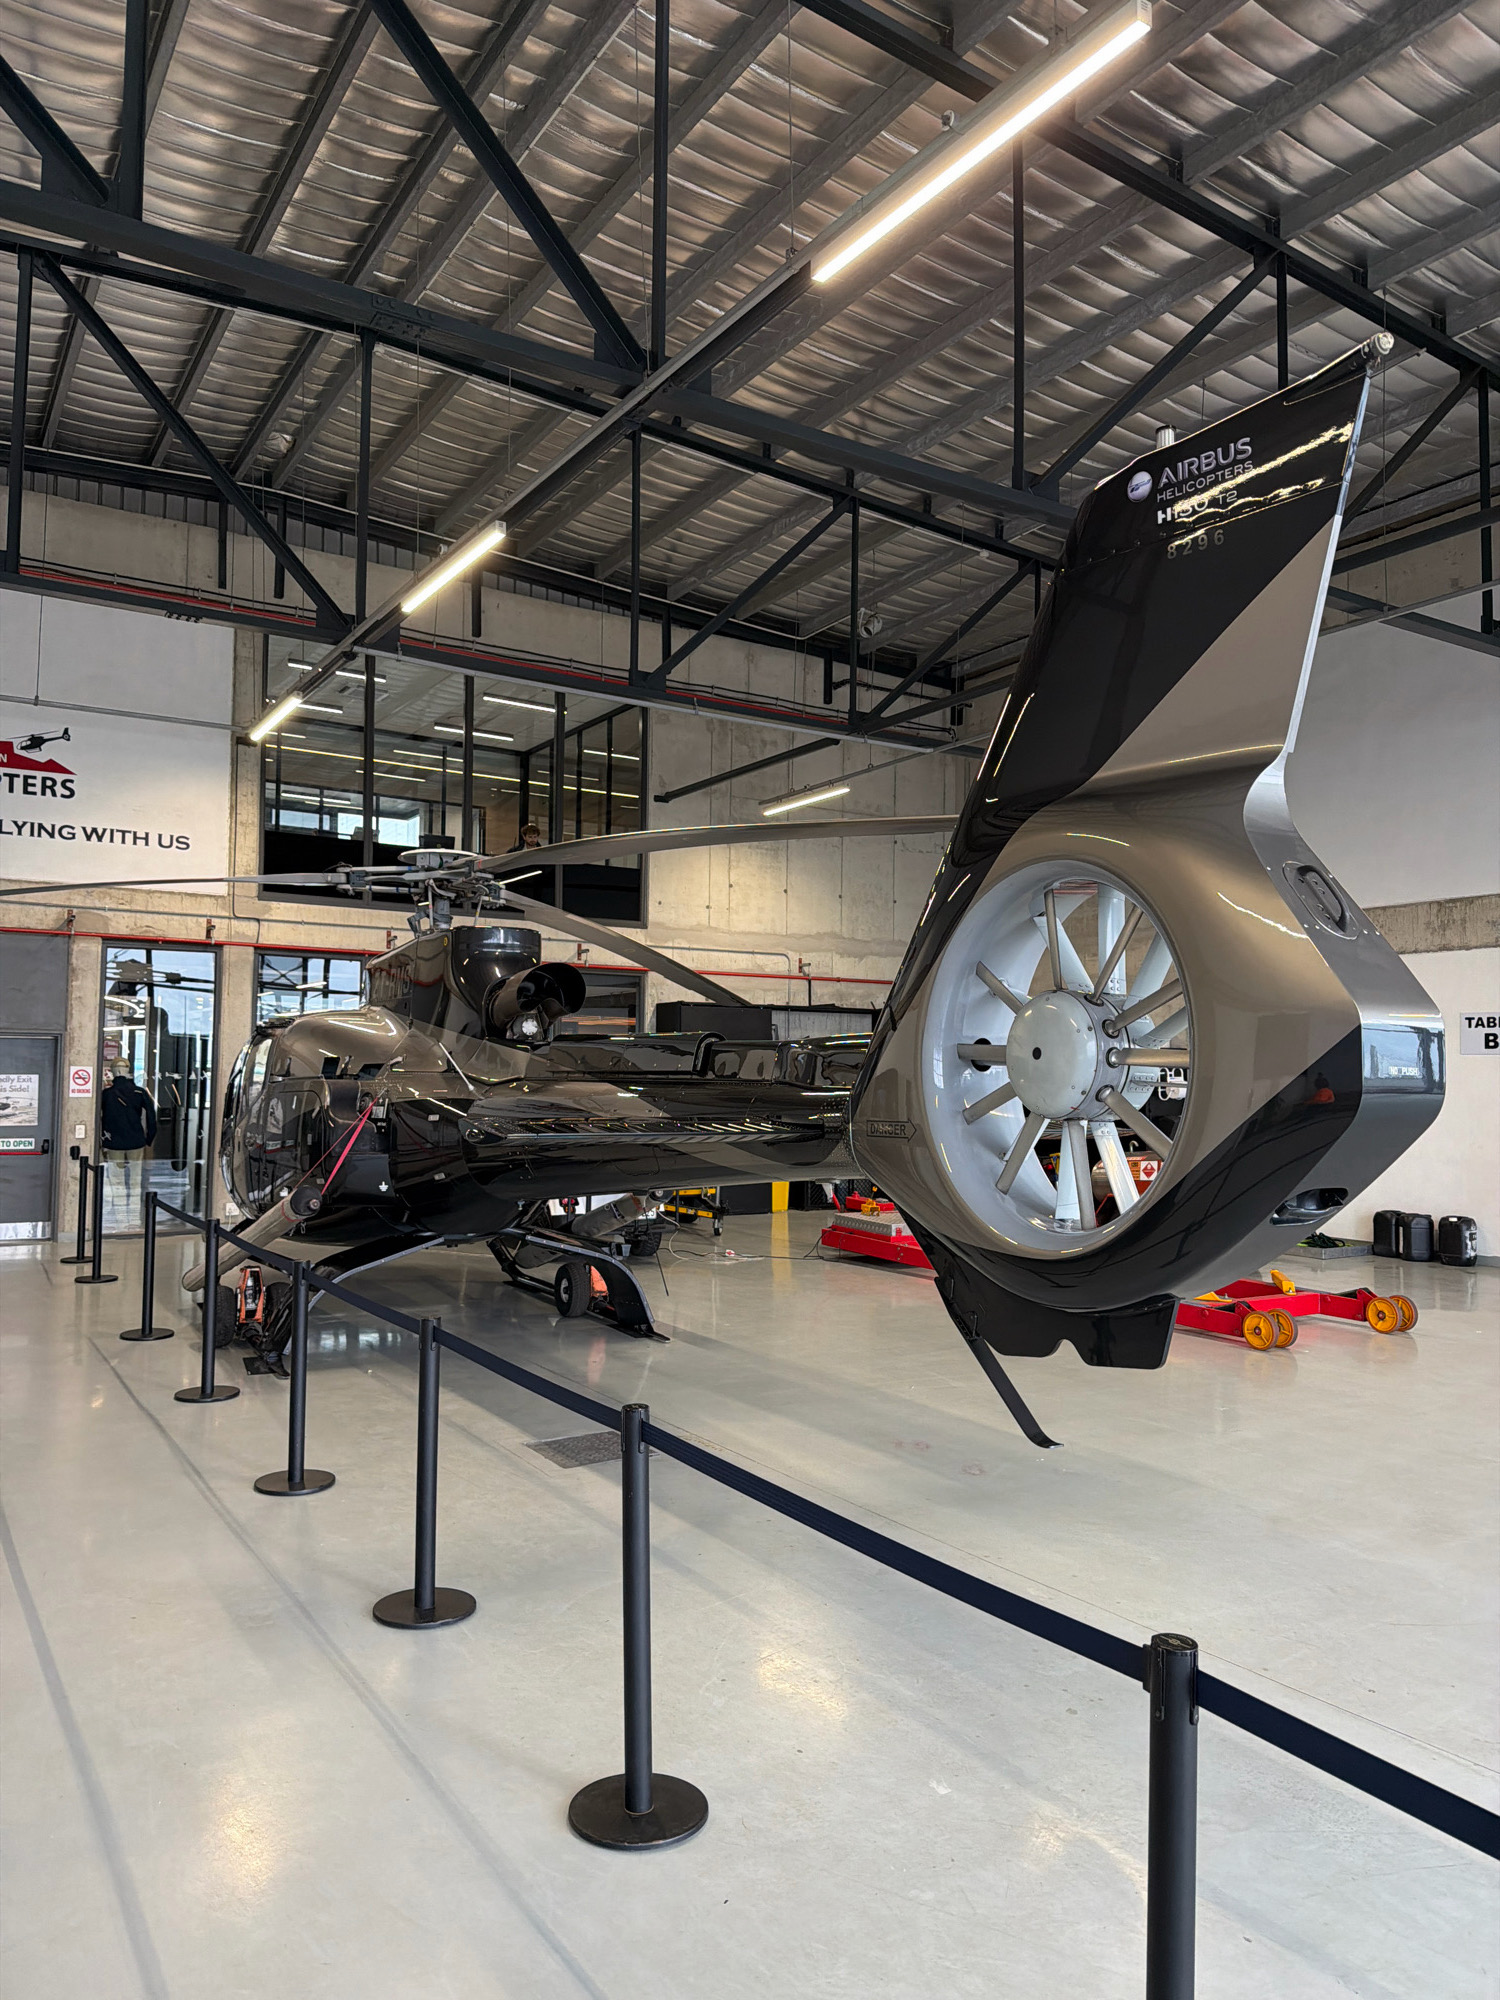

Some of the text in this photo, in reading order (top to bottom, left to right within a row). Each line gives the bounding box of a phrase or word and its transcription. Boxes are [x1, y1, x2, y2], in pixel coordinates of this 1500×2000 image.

[1157, 437, 1252, 489] AIRBUS
[1157, 461, 1254, 503] HELICOPTERS
[1217, 490, 1238, 505] T2
[1167, 529, 1225, 559] 8296
[0, 772, 76, 799] TERS
[0, 819, 191, 850] LYING WITH US
[1464, 1016, 1500, 1029] TAB
[870, 1123, 907, 1136] DANGER
[1, 1140, 33, 1148] TO OPEN
